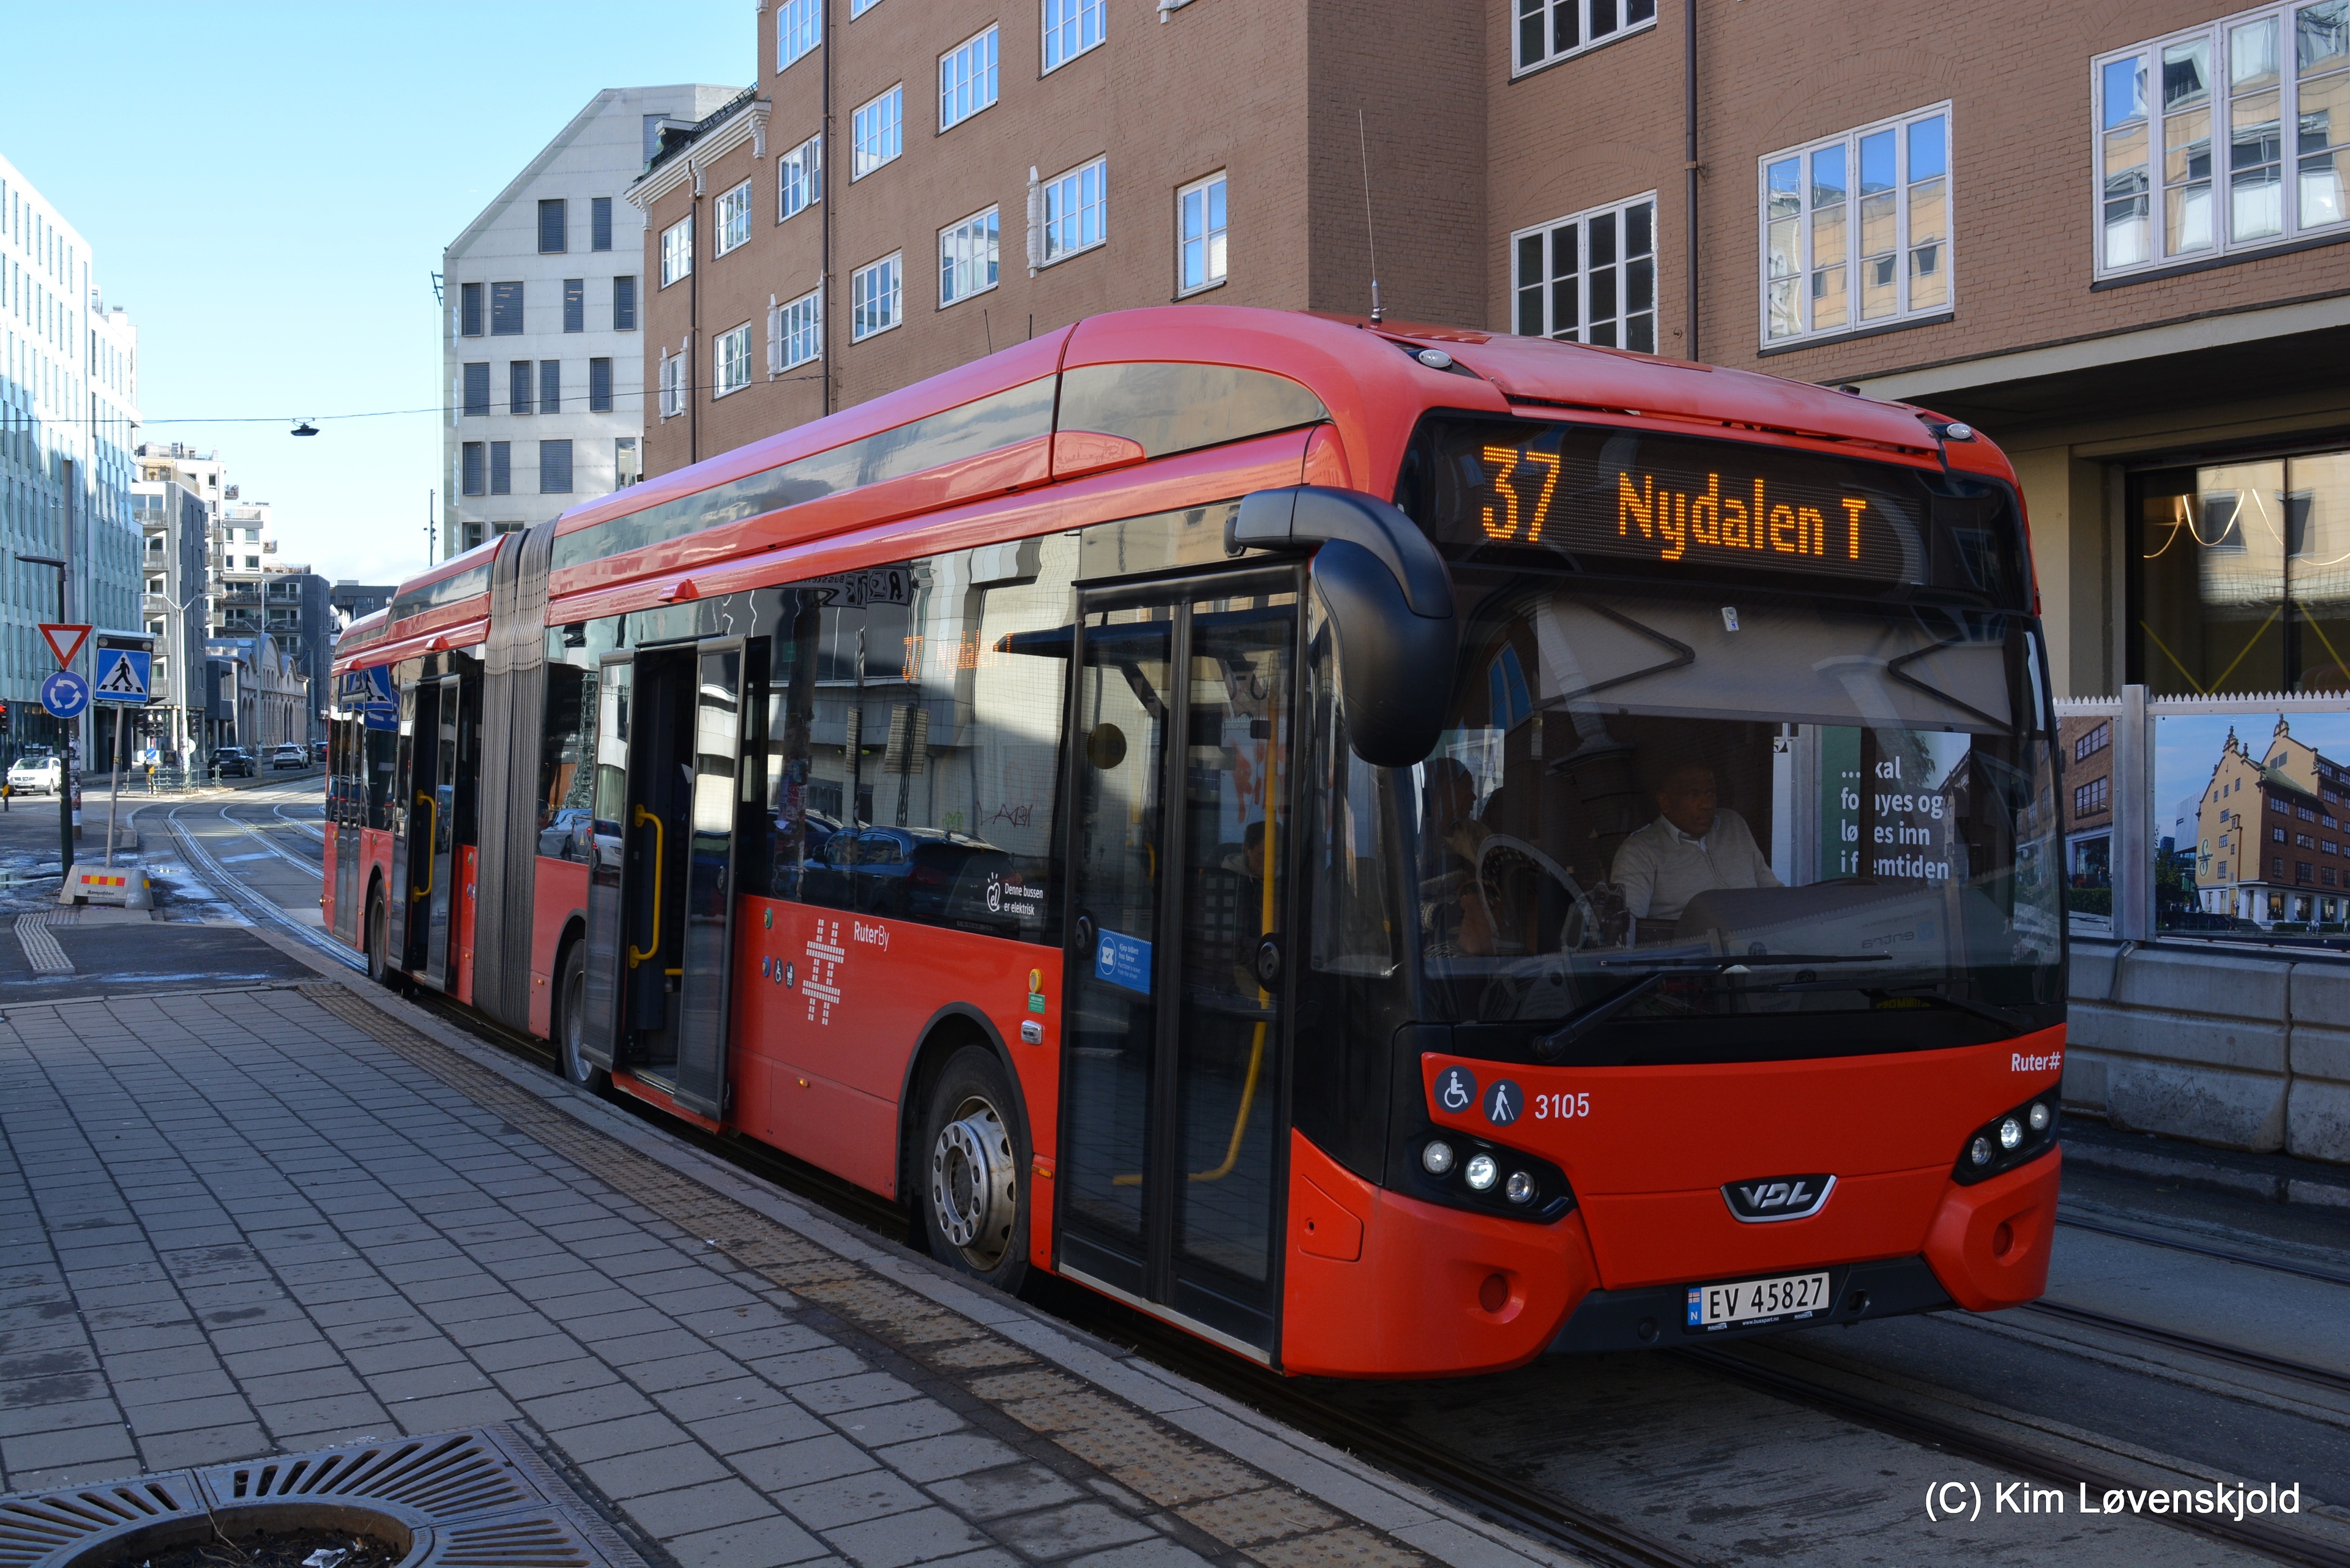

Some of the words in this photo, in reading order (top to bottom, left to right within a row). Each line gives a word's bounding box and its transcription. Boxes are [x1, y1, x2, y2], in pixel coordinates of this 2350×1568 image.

[1483, 446, 1560, 542] 37
[1620, 471, 1824, 560] Nydalen
[1842, 498, 1866, 559] T
[903, 636, 922, 680] 37
[936, 629, 999, 679] Nydalen
[1918, 795, 1944, 819] og
[1899, 821, 1930, 845] inn
[1841, 849, 1846, 873] i
[1004, 883, 1022, 896] Denne
[1023, 885, 1043, 899] bussen
[1004, 902, 1010, 912] er
[1011, 902, 1035, 916] elektrisk
[854, 920, 890, 952] RuterBy
[2011, 1051, 2061, 1072] Ruter#
[1535, 1092, 1589, 1119] 3105
[1739, 1181, 1813, 1209] VDL
[1710, 1288, 1739, 1320] EV
[1751, 1277, 1823, 1313] 45827
[1690, 1312, 1698, 1321] N
[1742, 1316, 1780, 1326] www.busspart.no
